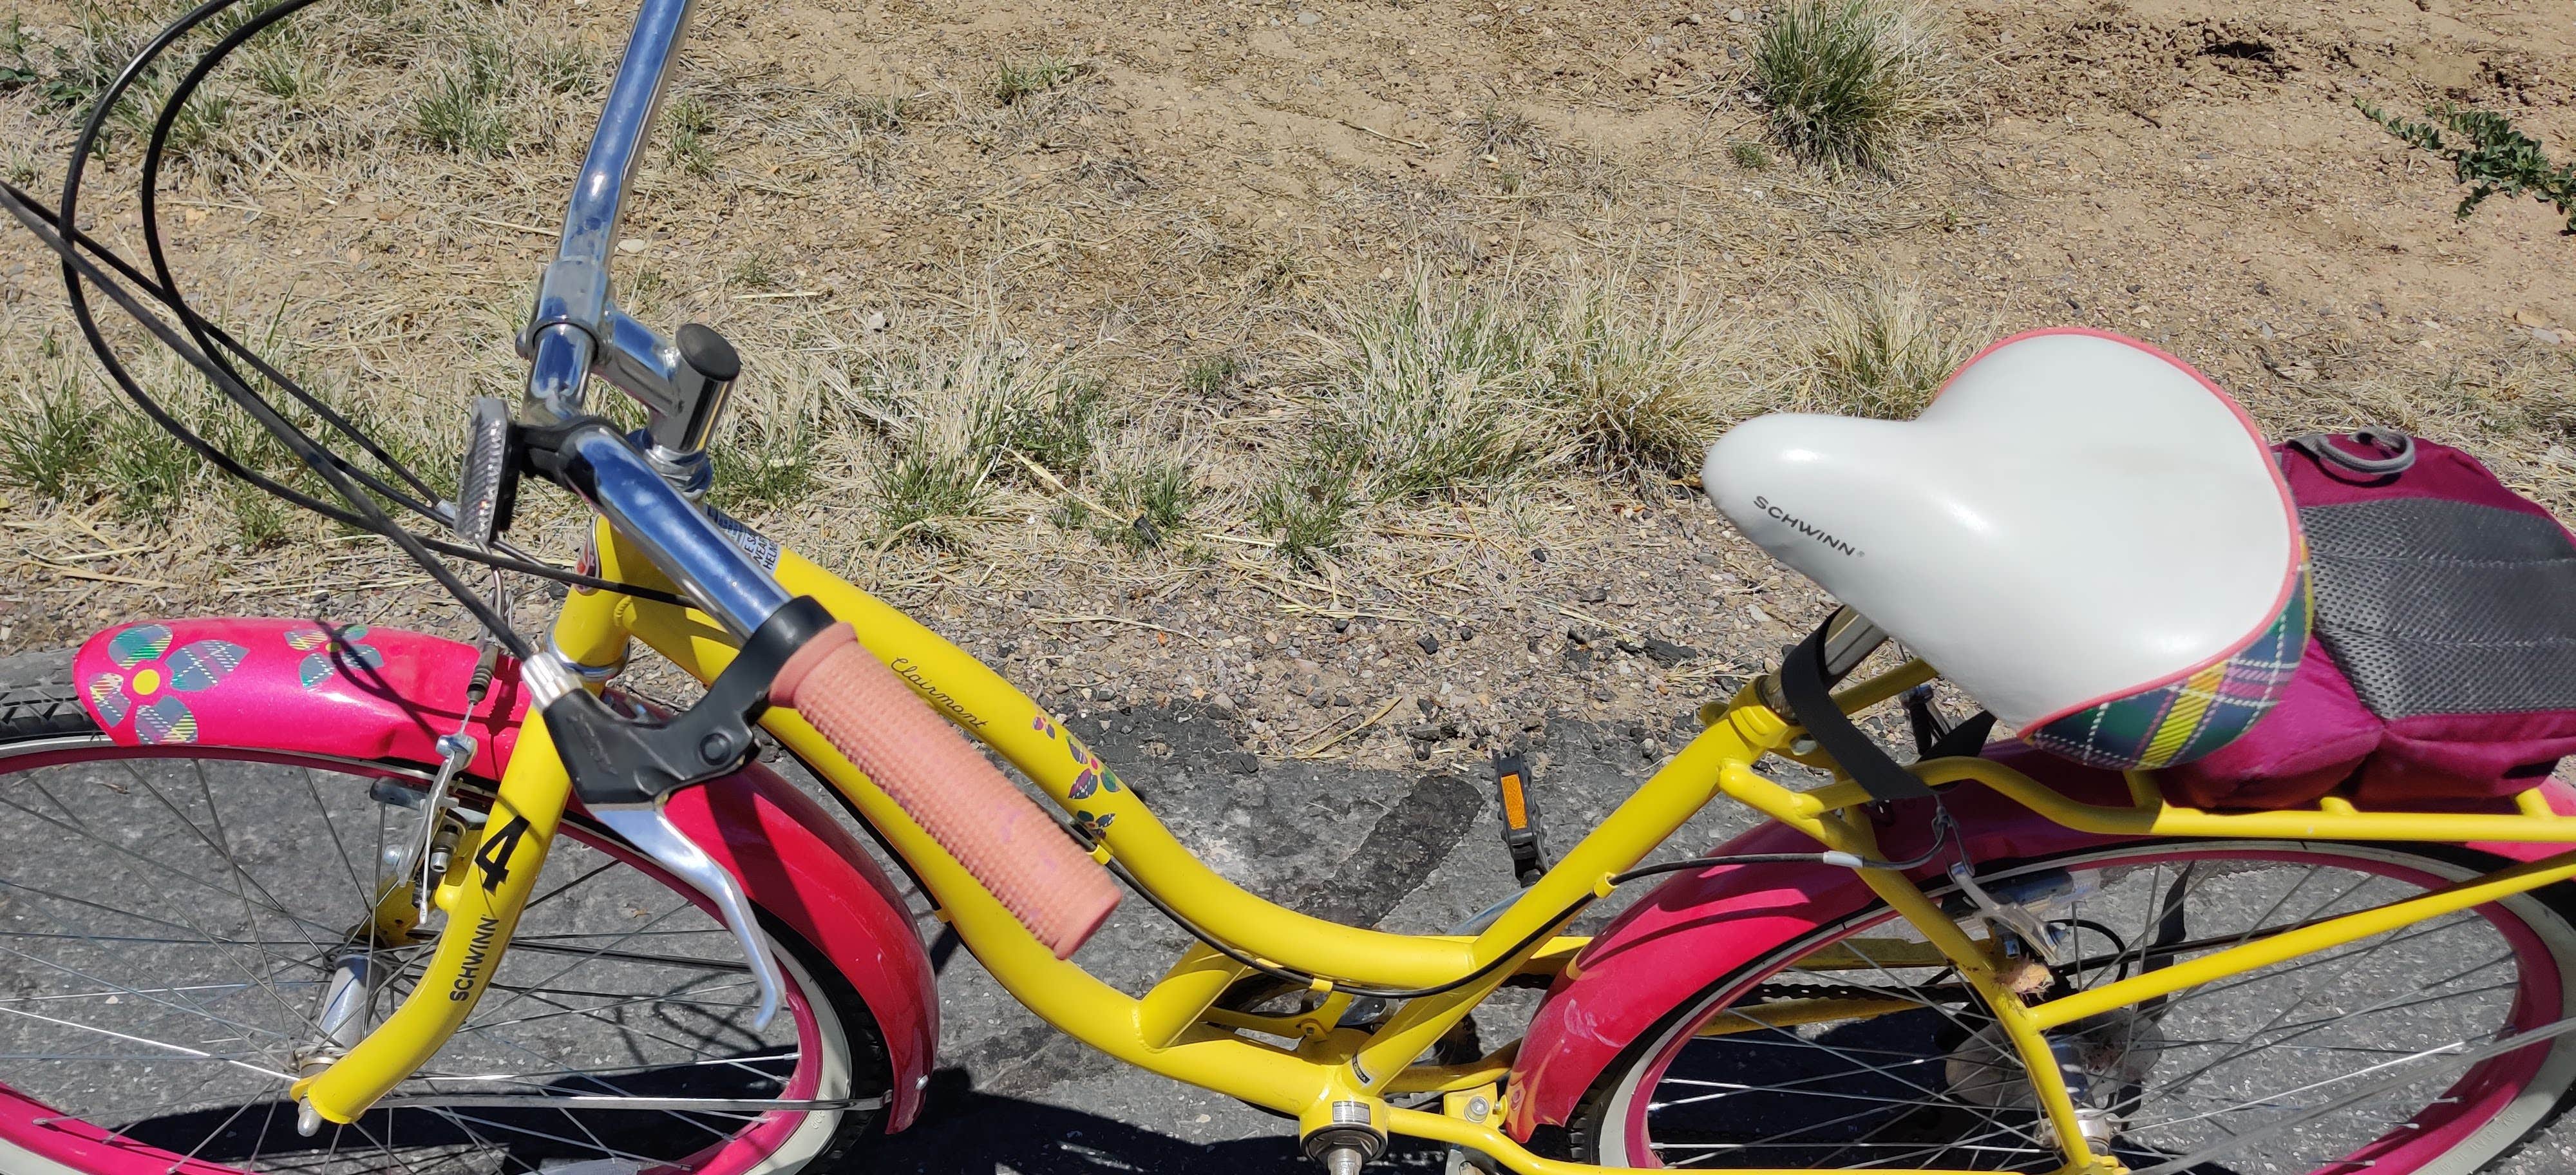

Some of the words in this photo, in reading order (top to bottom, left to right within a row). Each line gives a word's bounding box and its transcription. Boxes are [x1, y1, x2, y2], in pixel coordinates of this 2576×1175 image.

[1753, 495, 1855, 557] SCHWINN
[891, 657, 989, 729] Clairmont
[475, 814, 531, 897] 4
[449, 916, 499, 1002] SCHWINN
